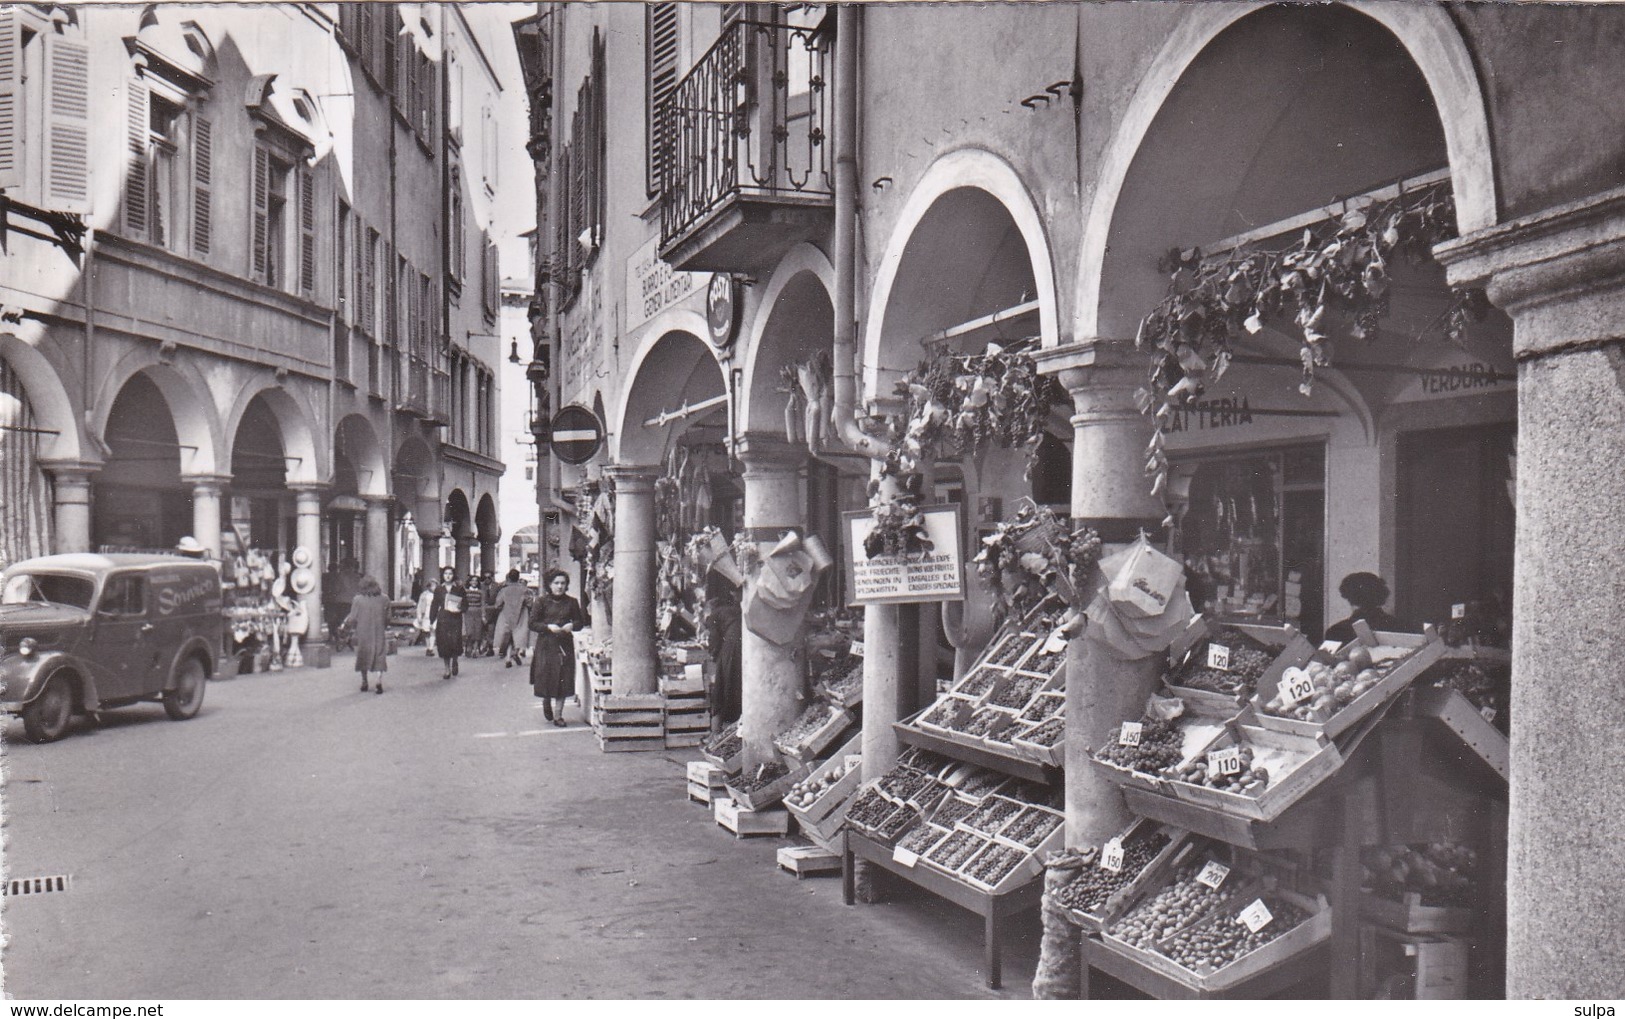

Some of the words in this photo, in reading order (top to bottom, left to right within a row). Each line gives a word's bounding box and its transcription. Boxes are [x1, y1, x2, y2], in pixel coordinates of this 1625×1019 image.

[1420, 362, 1498, 394] VERDURA
[892, 576, 902, 584] IN
[908, 574, 940, 583] EMBALLES
[943, 573, 955, 581] EN
[1213, 654, 1227, 668] 120
[1289, 681, 1311, 700] 120
[1217, 757, 1238, 773] 110
[1106, 854, 1121, 869] 150
[1205, 871, 1223, 885] 200
